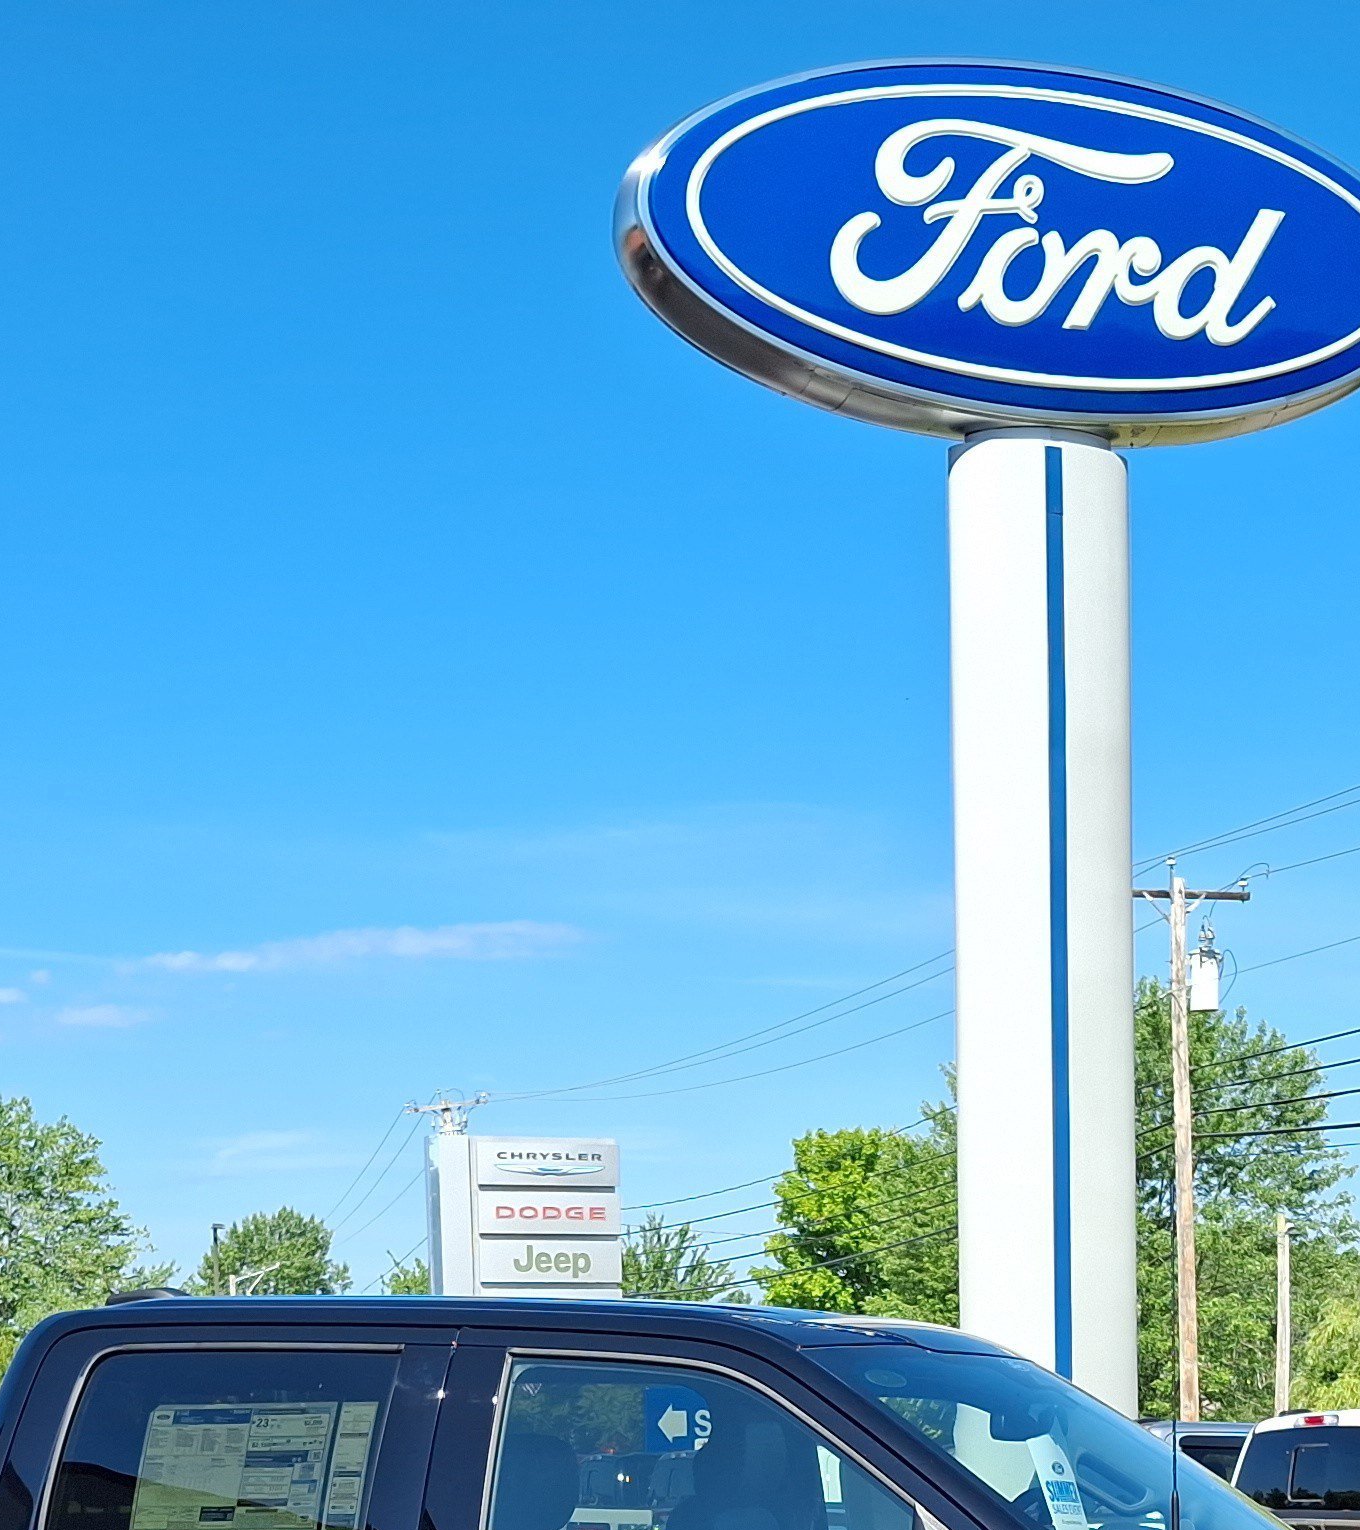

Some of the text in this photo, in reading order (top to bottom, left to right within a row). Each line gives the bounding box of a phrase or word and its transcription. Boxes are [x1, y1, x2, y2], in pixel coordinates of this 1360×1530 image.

[830, 117, 1286, 346] Ford
[496, 1151, 603, 1162] CHRYSLER
[495, 1206, 607, 1221] DODGE
[513, 1244, 592, 1279] Jeep
